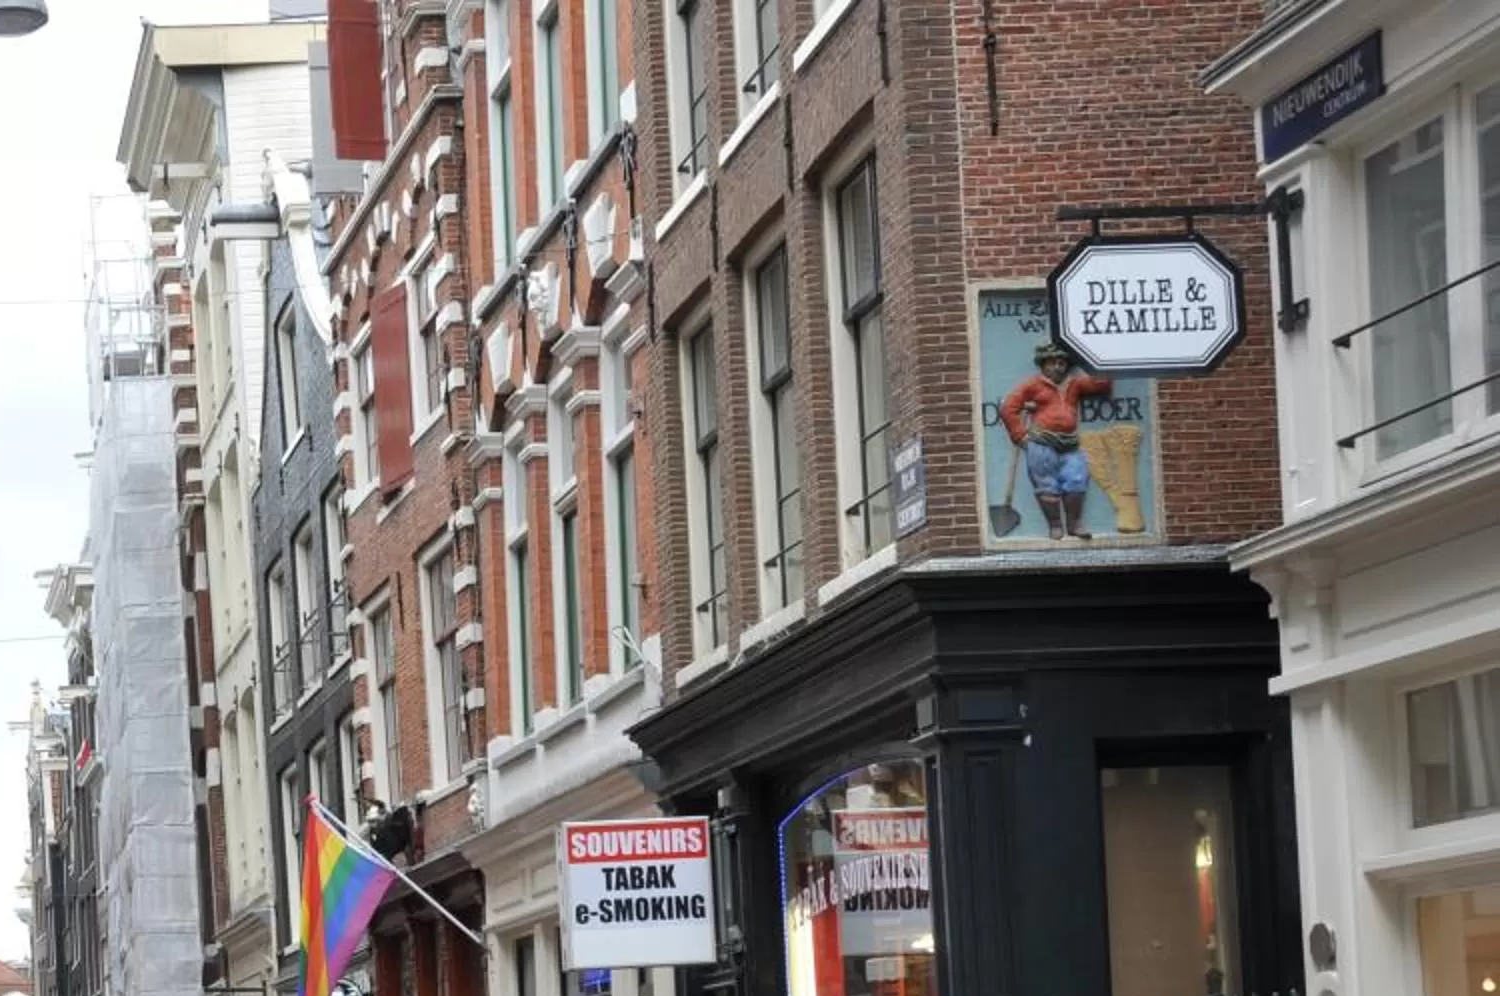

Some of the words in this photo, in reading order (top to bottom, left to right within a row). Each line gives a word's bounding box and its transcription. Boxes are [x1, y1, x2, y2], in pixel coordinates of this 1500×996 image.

[1086, 277, 1174, 306] DILLE
[1185, 277, 1208, 303] &
[983, 300, 1023, 319] ALLE
[1080, 306, 1218, 335] KAMILLE
[1017, 319, 1046, 333] VAN
[1080, 397, 1144, 423] BOER
[571, 828, 702, 857] SOUVENIRS
[601, 864, 677, 891] TABAK
[575, 894, 707, 925] e-SMOKING
